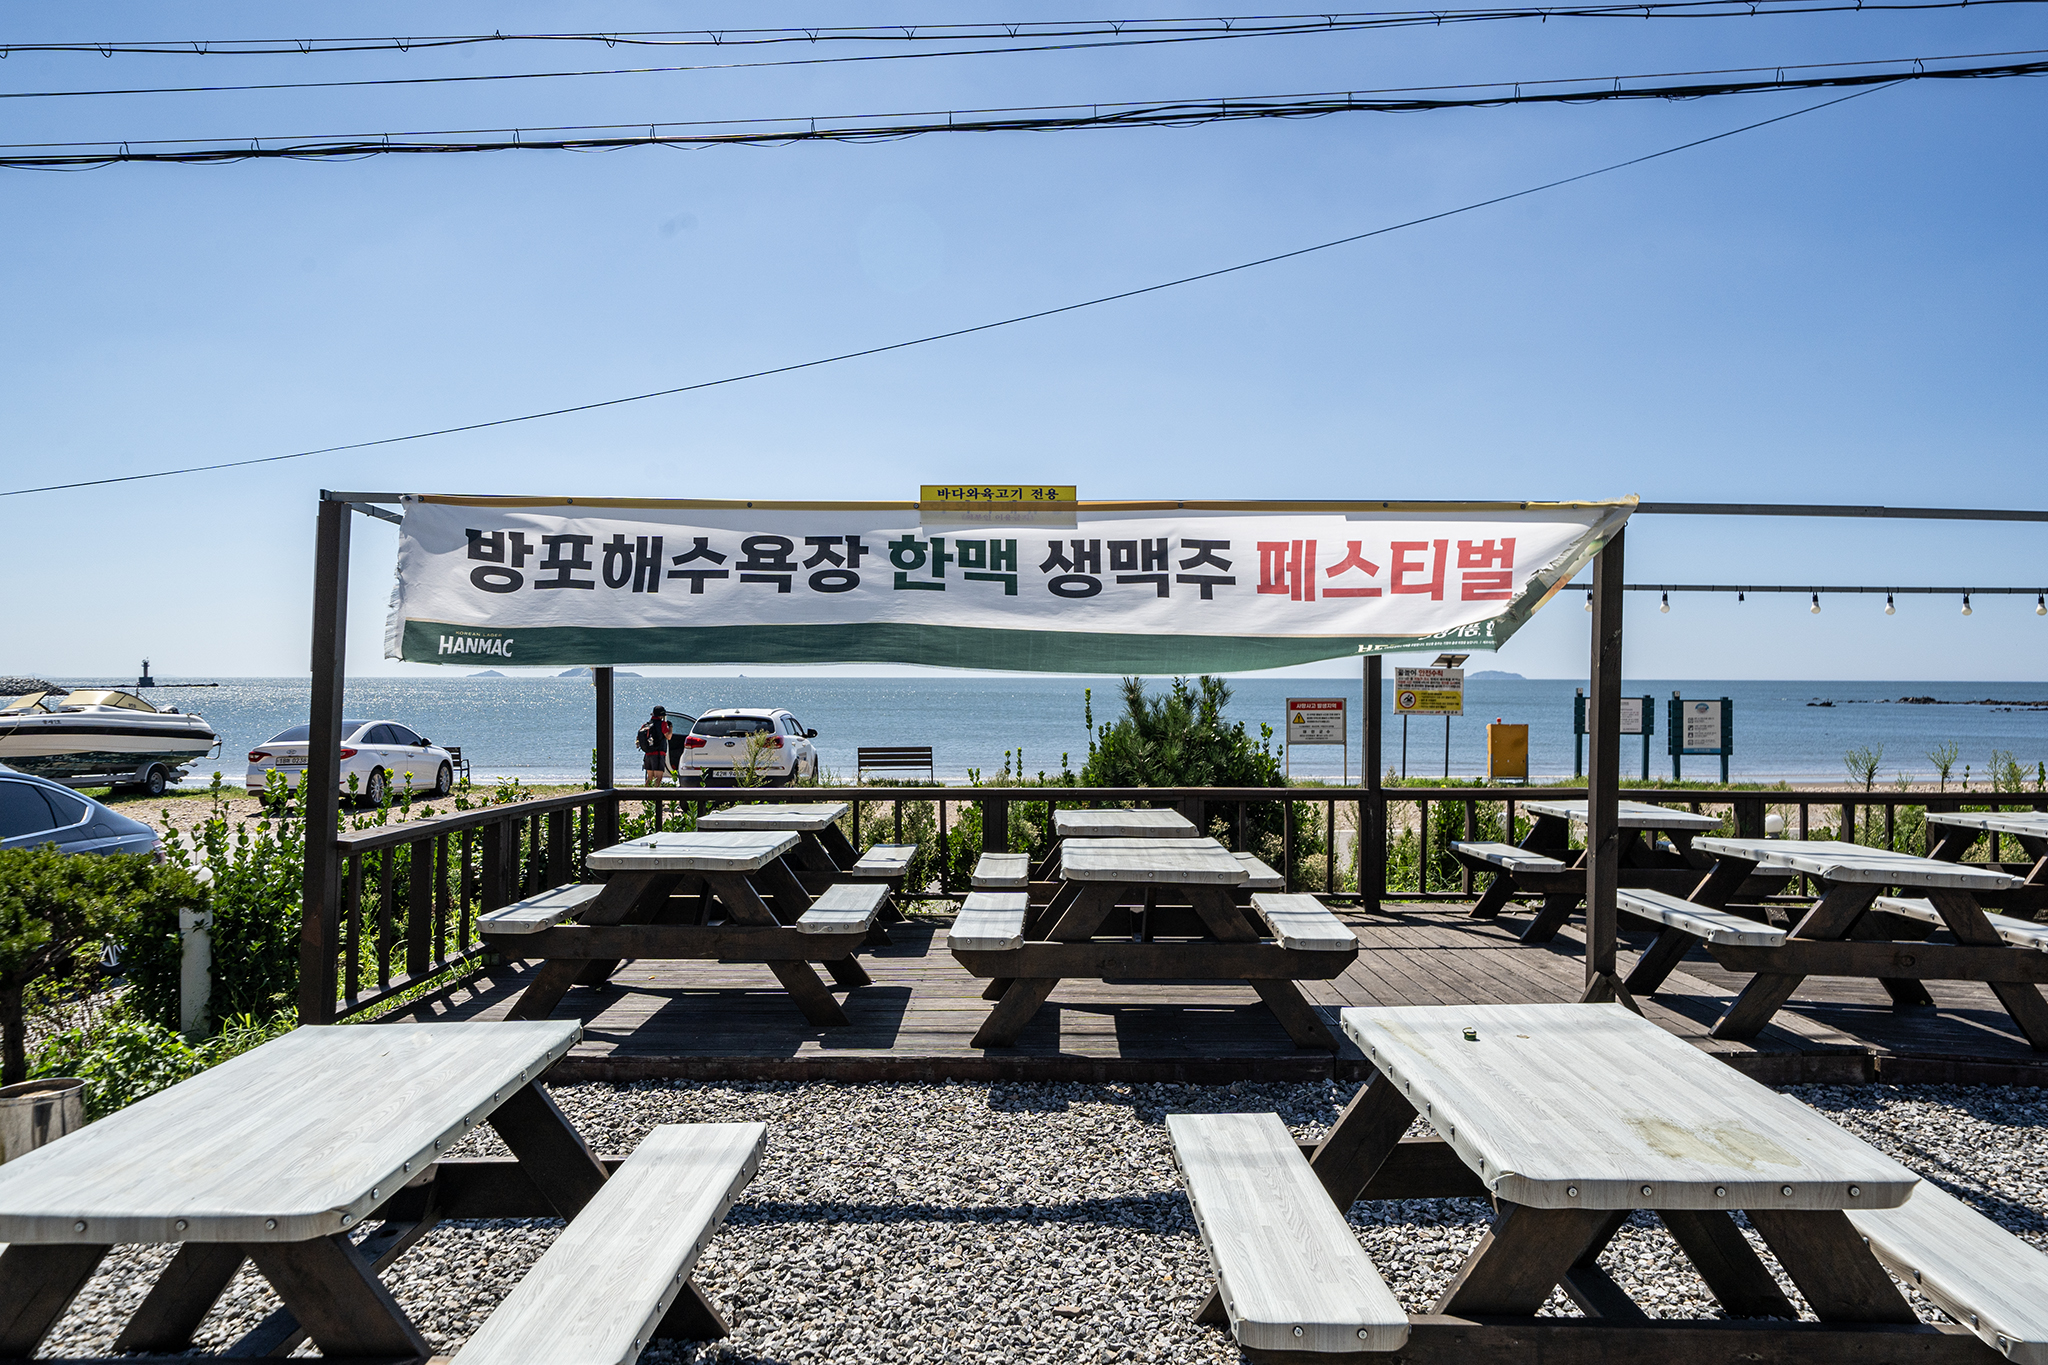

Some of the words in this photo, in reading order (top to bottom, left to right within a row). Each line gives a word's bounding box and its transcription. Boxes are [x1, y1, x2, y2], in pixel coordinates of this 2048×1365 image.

[937, 487, 1023, 500] 바다와육고기
[1030, 487, 1059, 500] 전용
[465, 528, 869, 595] 방포해수욕장
[888, 534, 1018, 596] 한맥
[1039, 538, 1237, 600] 생맥주
[1256, 537, 1517, 602] 페스티벌
[438, 634, 514, 658] HANMAC
